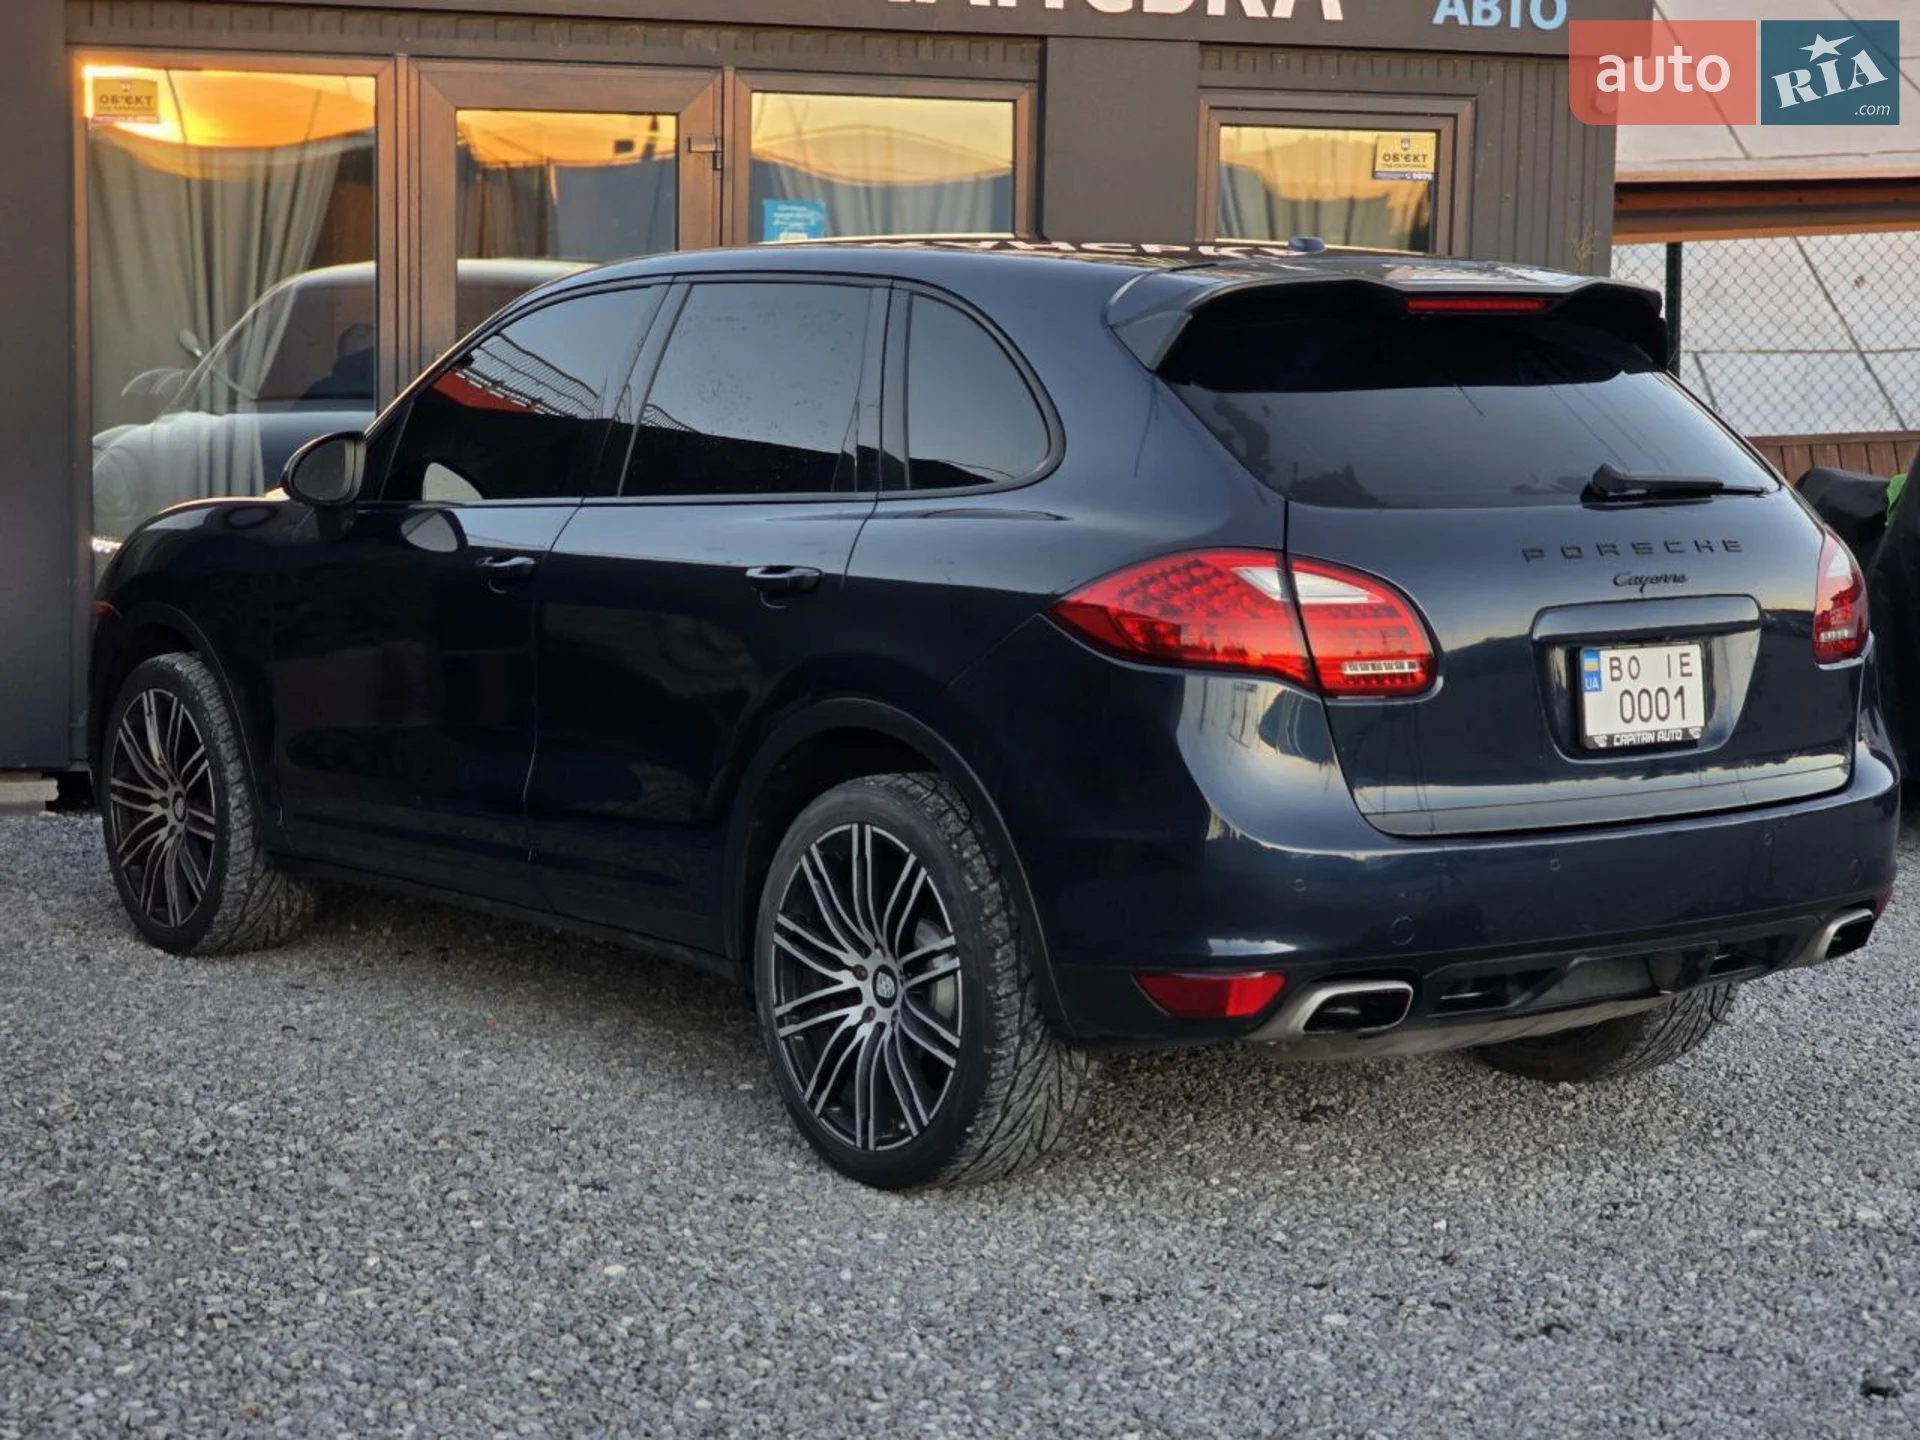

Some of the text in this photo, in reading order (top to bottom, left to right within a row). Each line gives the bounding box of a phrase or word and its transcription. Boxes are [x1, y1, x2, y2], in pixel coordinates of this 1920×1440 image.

[1522, 539, 1744, 564] PORSCHE
[1612, 571, 1688, 593] Cayenne
[1585, 677, 1600, 690] UA
[1619, 684, 1686, 724] 0001
[1613, 729, 1682, 747] CAPITAN AUTO
